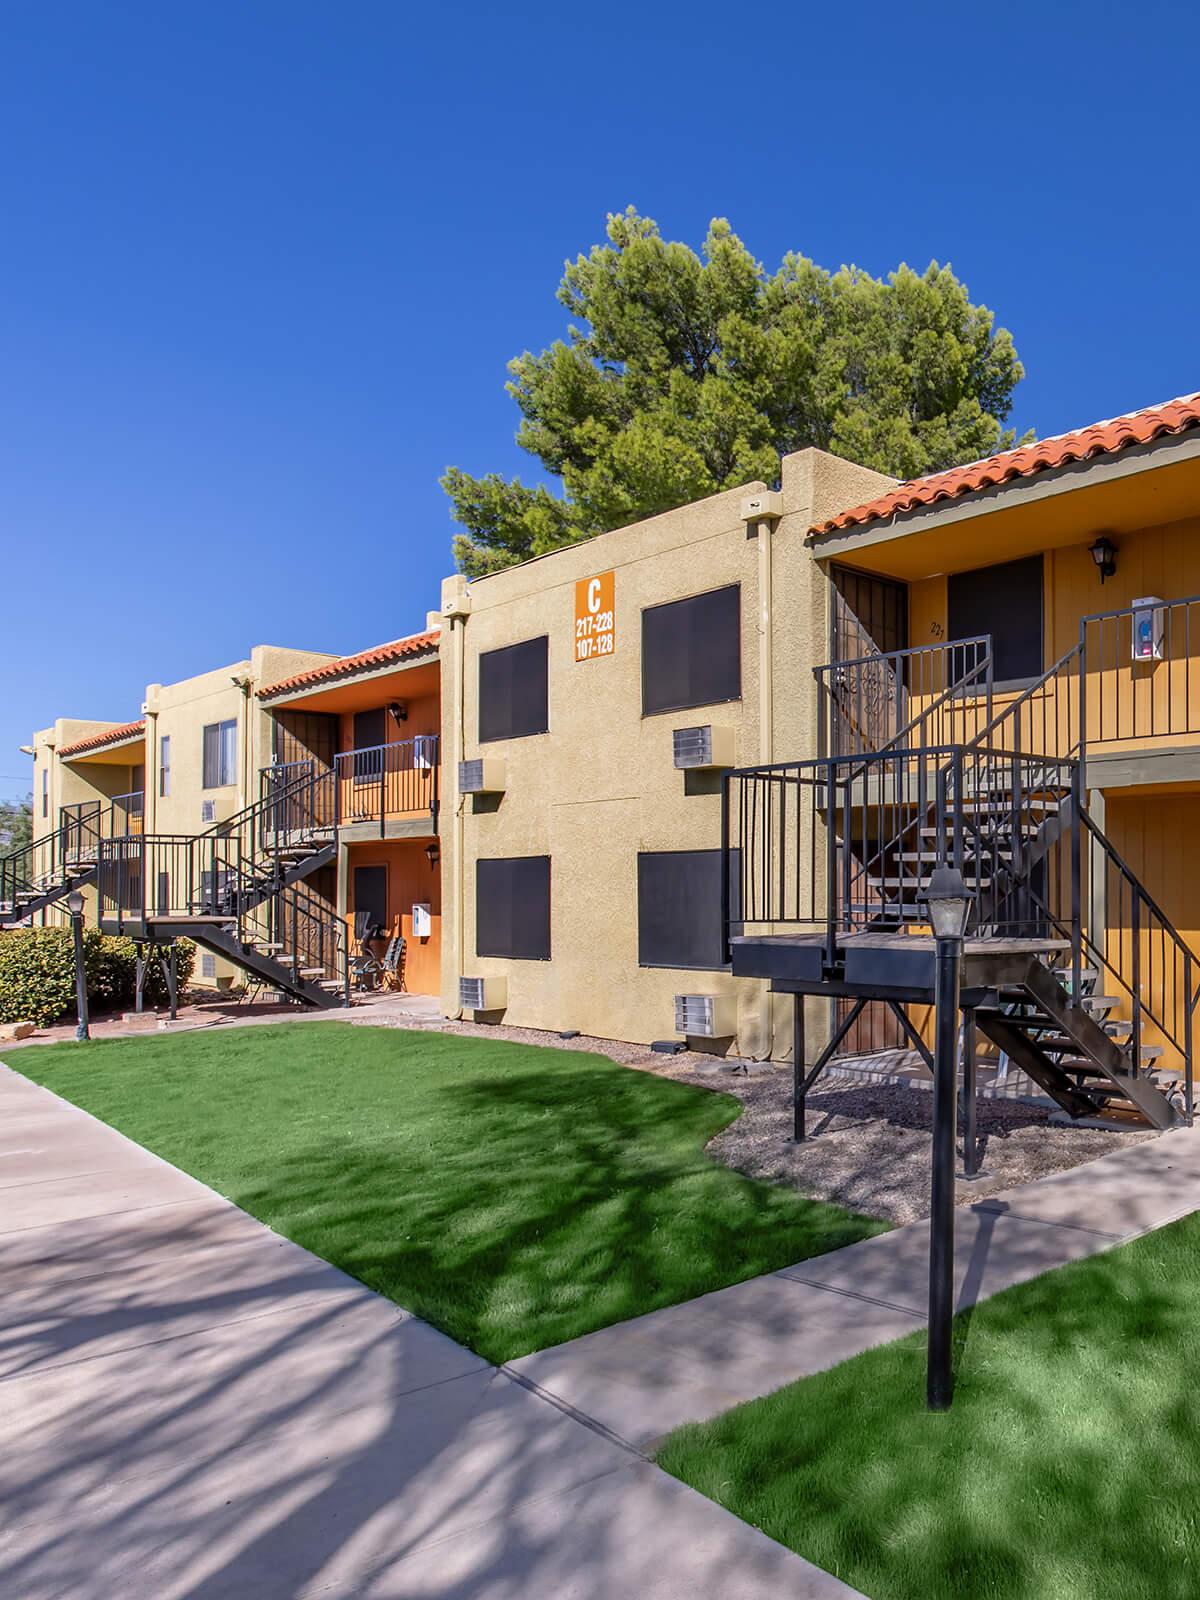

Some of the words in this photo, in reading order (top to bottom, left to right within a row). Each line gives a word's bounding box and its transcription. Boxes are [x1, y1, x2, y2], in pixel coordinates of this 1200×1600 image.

[588, 578, 601, 613] C
[576, 611, 613, 637] 217-228
[576, 634, 613, 659] 107-128
